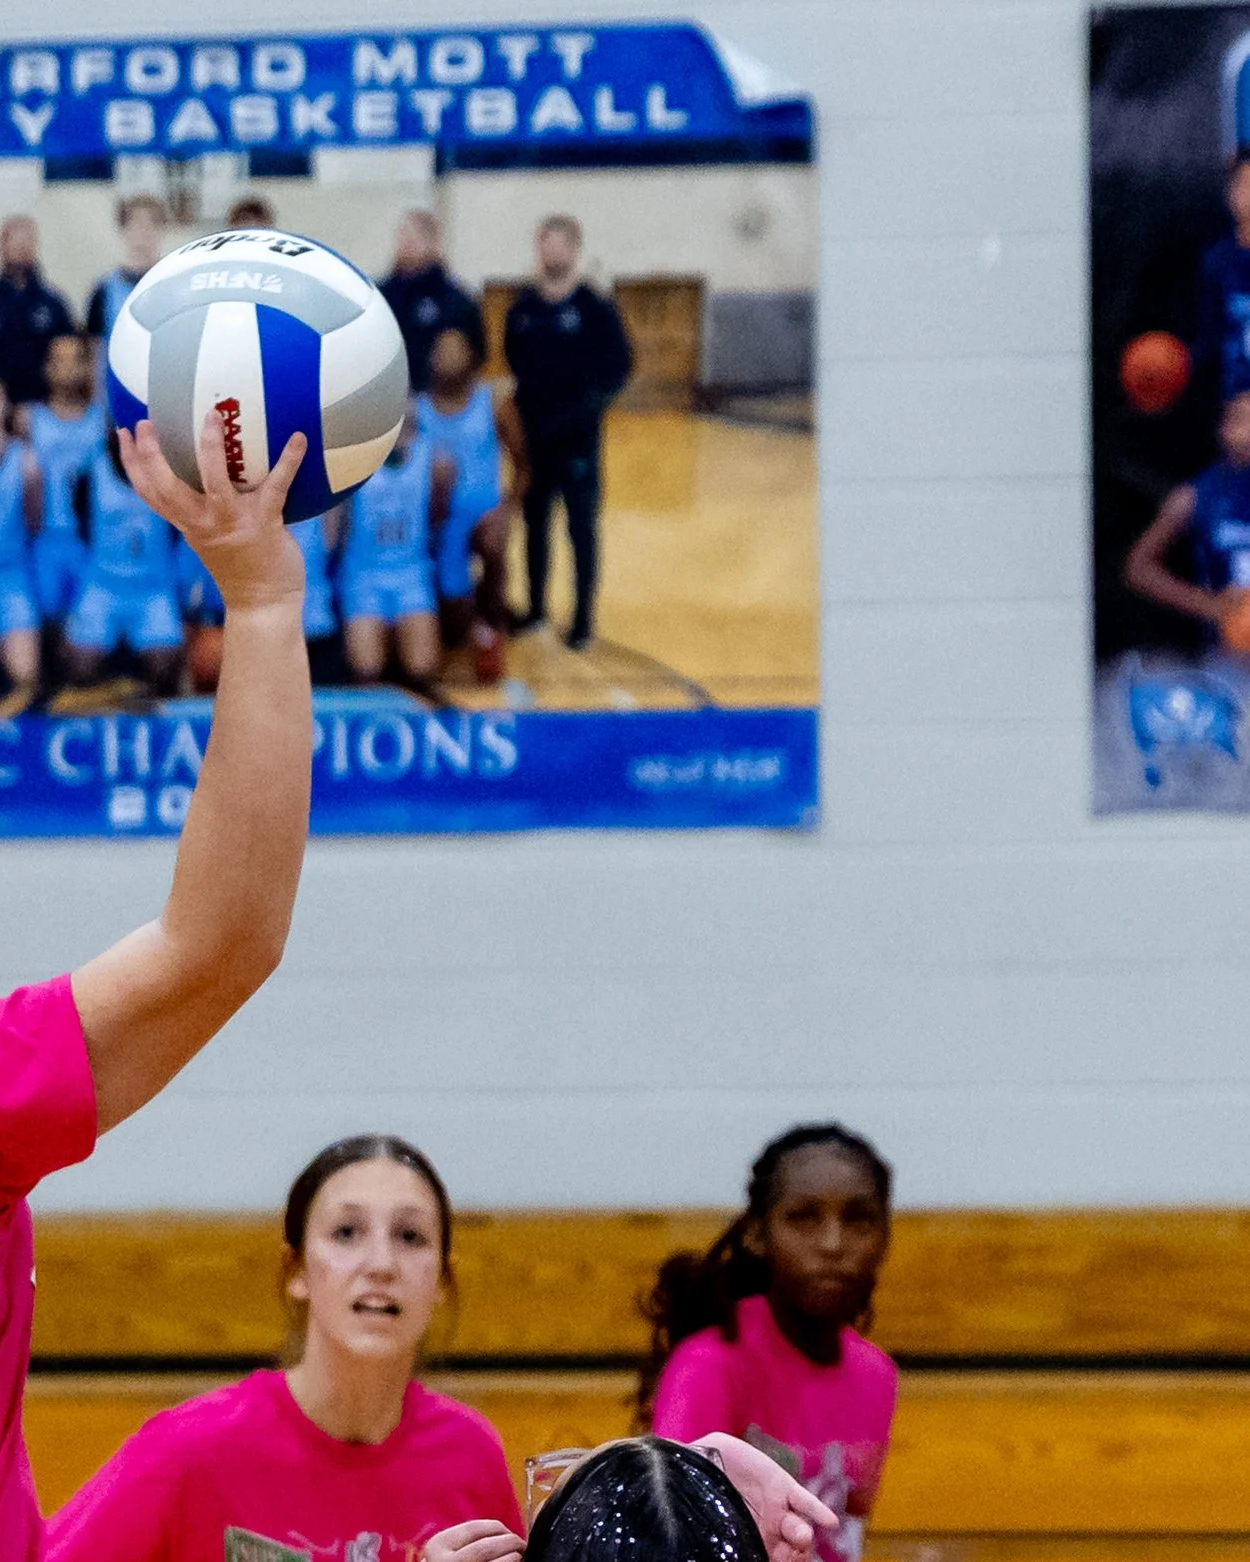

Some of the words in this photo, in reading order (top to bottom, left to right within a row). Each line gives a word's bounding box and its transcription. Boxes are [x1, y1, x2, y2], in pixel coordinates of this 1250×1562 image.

[352, 32, 596, 86] MOTT
[105, 84, 688, 148] BASKETBALL
[48, 714, 519, 786] CHAIONS
